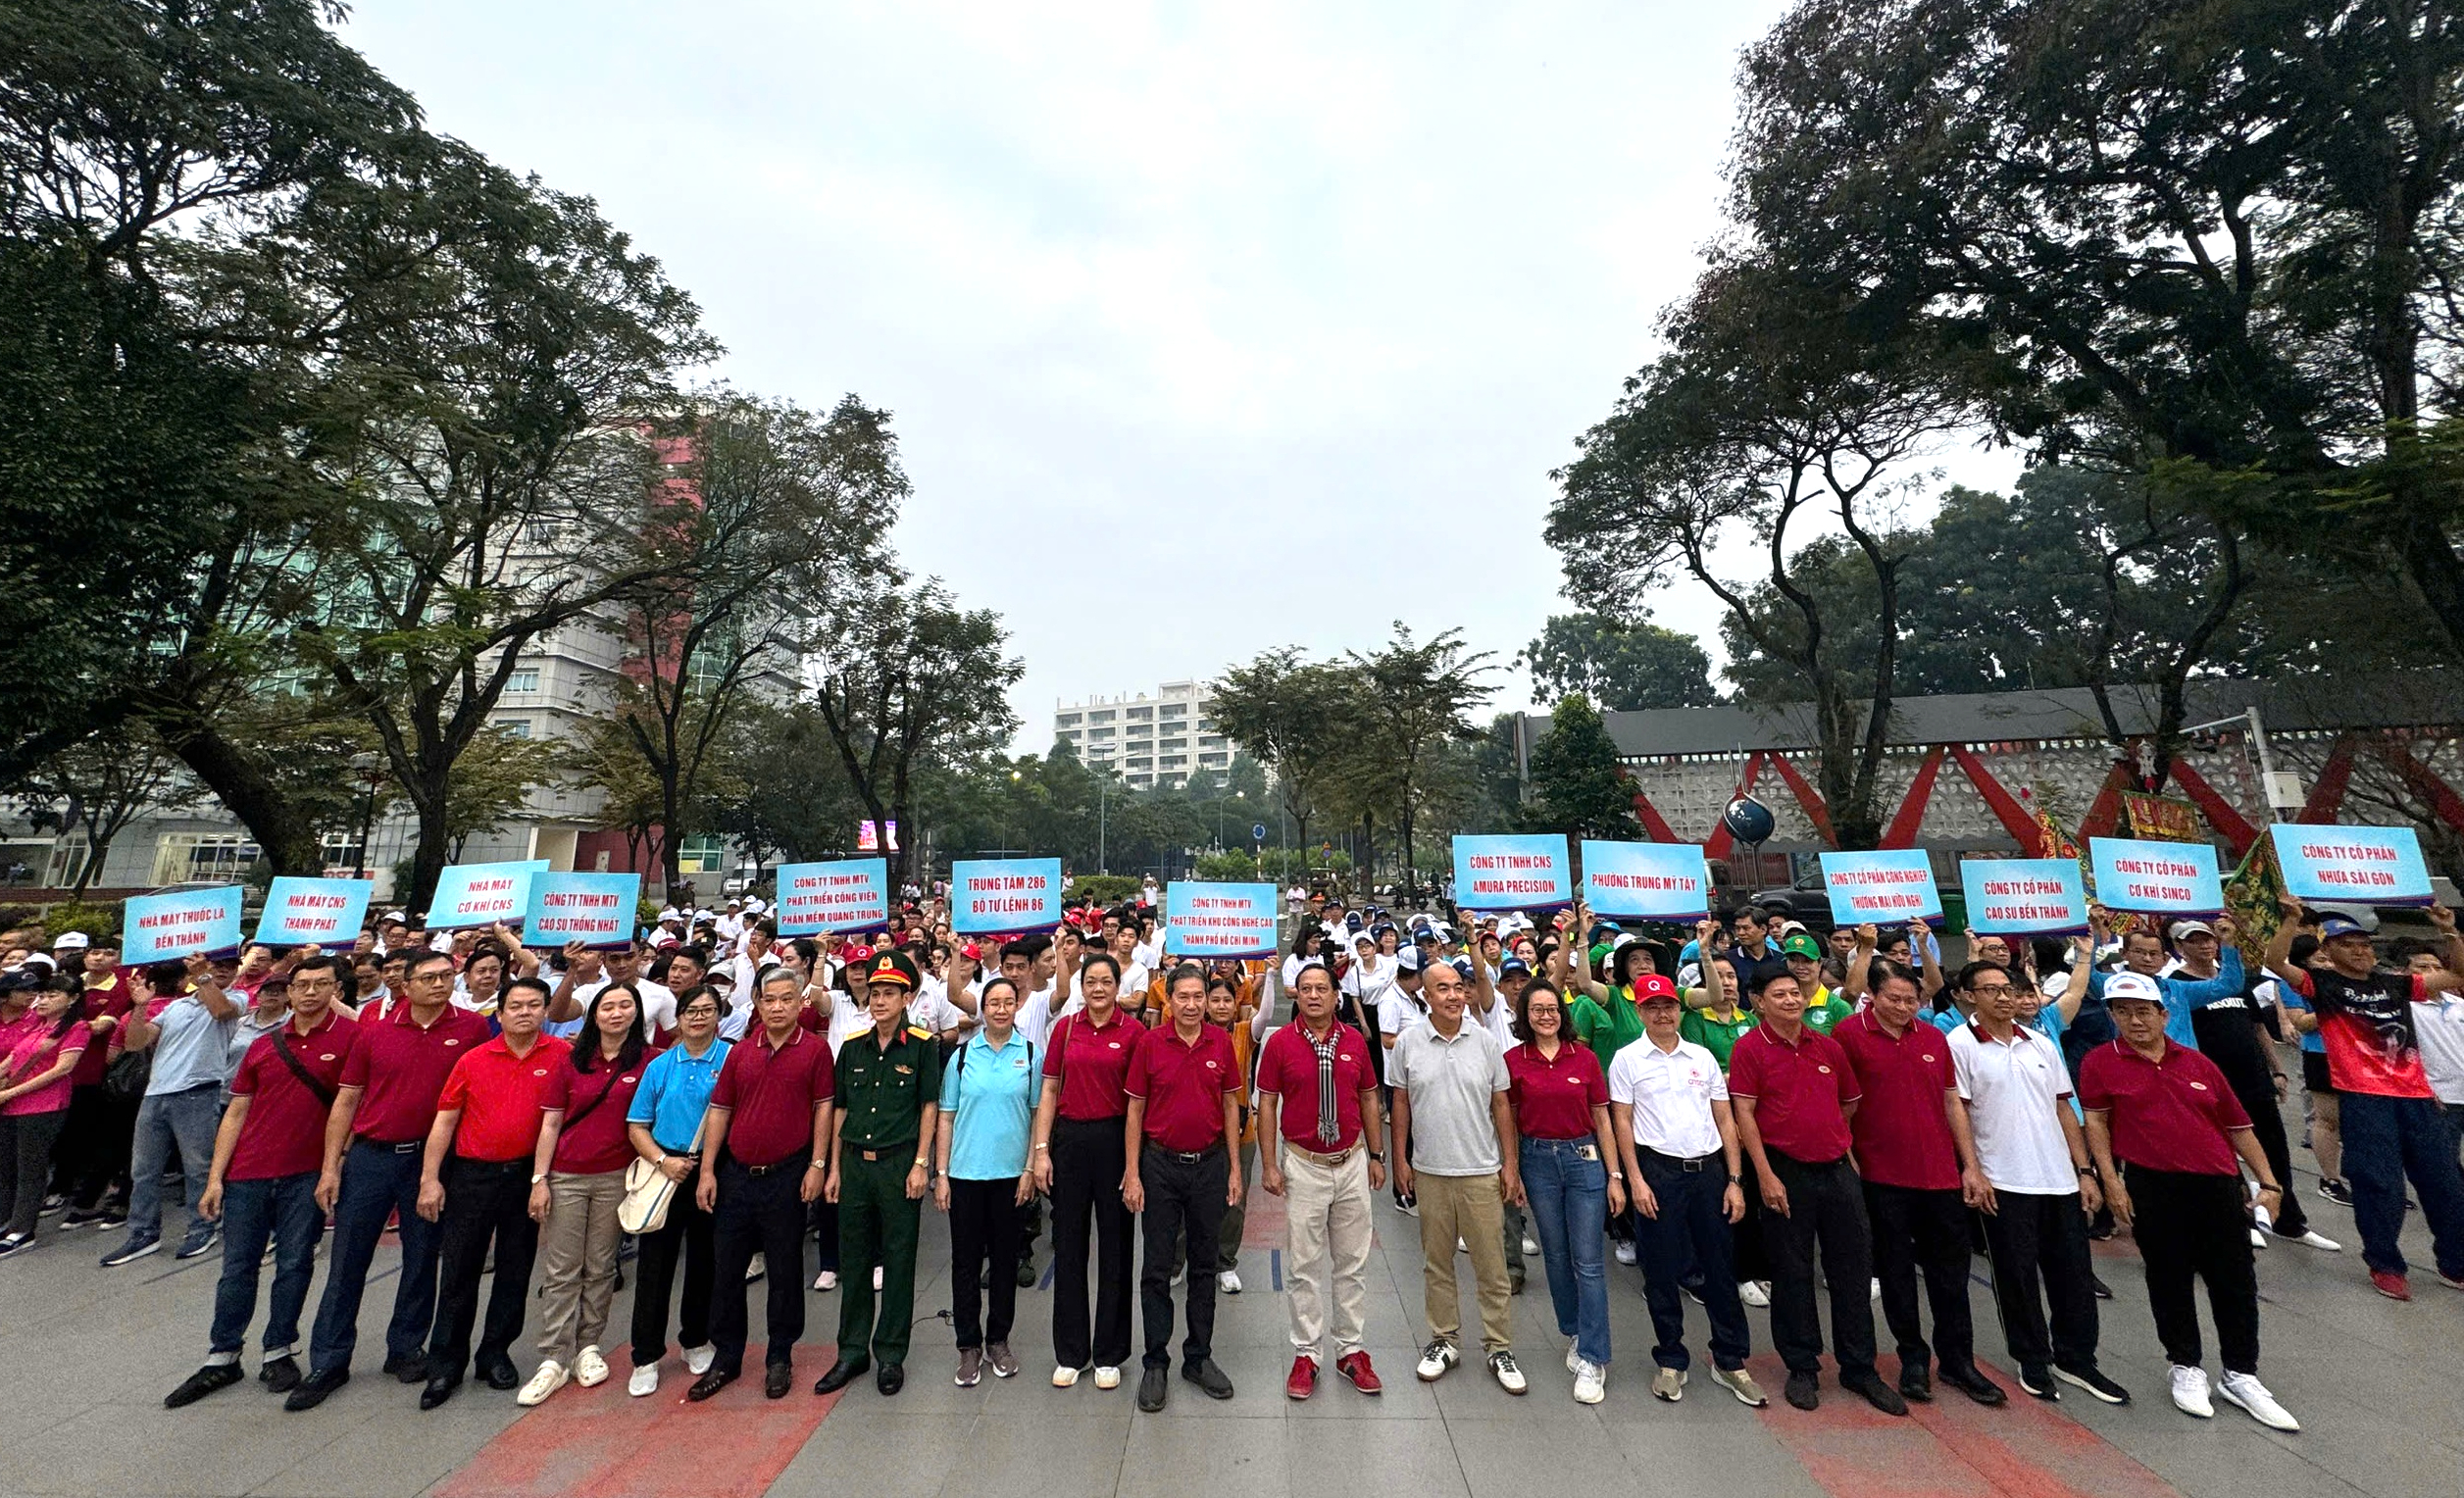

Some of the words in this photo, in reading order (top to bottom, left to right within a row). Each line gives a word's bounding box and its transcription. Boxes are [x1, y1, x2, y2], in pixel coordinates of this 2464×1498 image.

[2334, 846, 2346, 859] TY
[1495, 856, 1506, 869] TY
[1509, 856, 1532, 869] TNHH
[1534, 856, 1552, 868] CNS
[2143, 862, 2154, 874] TY
[819, 876, 828, 886] TY
[830, 875, 850, 886] TNHH
[852, 874, 870, 883] MTV
[968, 877, 1001, 891] TRUNG
[1028, 876, 1046, 889] 286
[1631, 875, 1661, 890] TRUNG
[1848, 872, 1857, 884] TY
[1473, 880, 1504, 893] AMURA
[1506, 880, 1555, 893] PRECISION
[2011, 882, 2021, 895] TY
[2162, 886, 2191, 901] SINCO
[327, 896, 347, 909] CNS
[492, 899, 514, 911] CNS
[569, 894, 578, 907] TY
[579, 894, 599, 907] TNHH
[601, 894, 620, 908] MTV
[1031, 898, 1043, 911] 86
[1211, 898, 1218, 908] TY
[1221, 899, 1237, 909] TNHH
[1238, 899, 1252, 909] MTV
[828, 911, 855, 923] QUANG
[857, 909, 883, 920] TRUNG
[1986, 907, 2003, 920] CAO
[2006, 907, 2018, 920] SU
[538, 918, 554, 930] CAO
[556, 918, 568, 930] SU
[1208, 917, 1222, 926] KHU
[1260, 918, 1273, 927] CAO
[1242, 936, 1260, 946] MINH
[1648, 980, 1661, 991] Q
